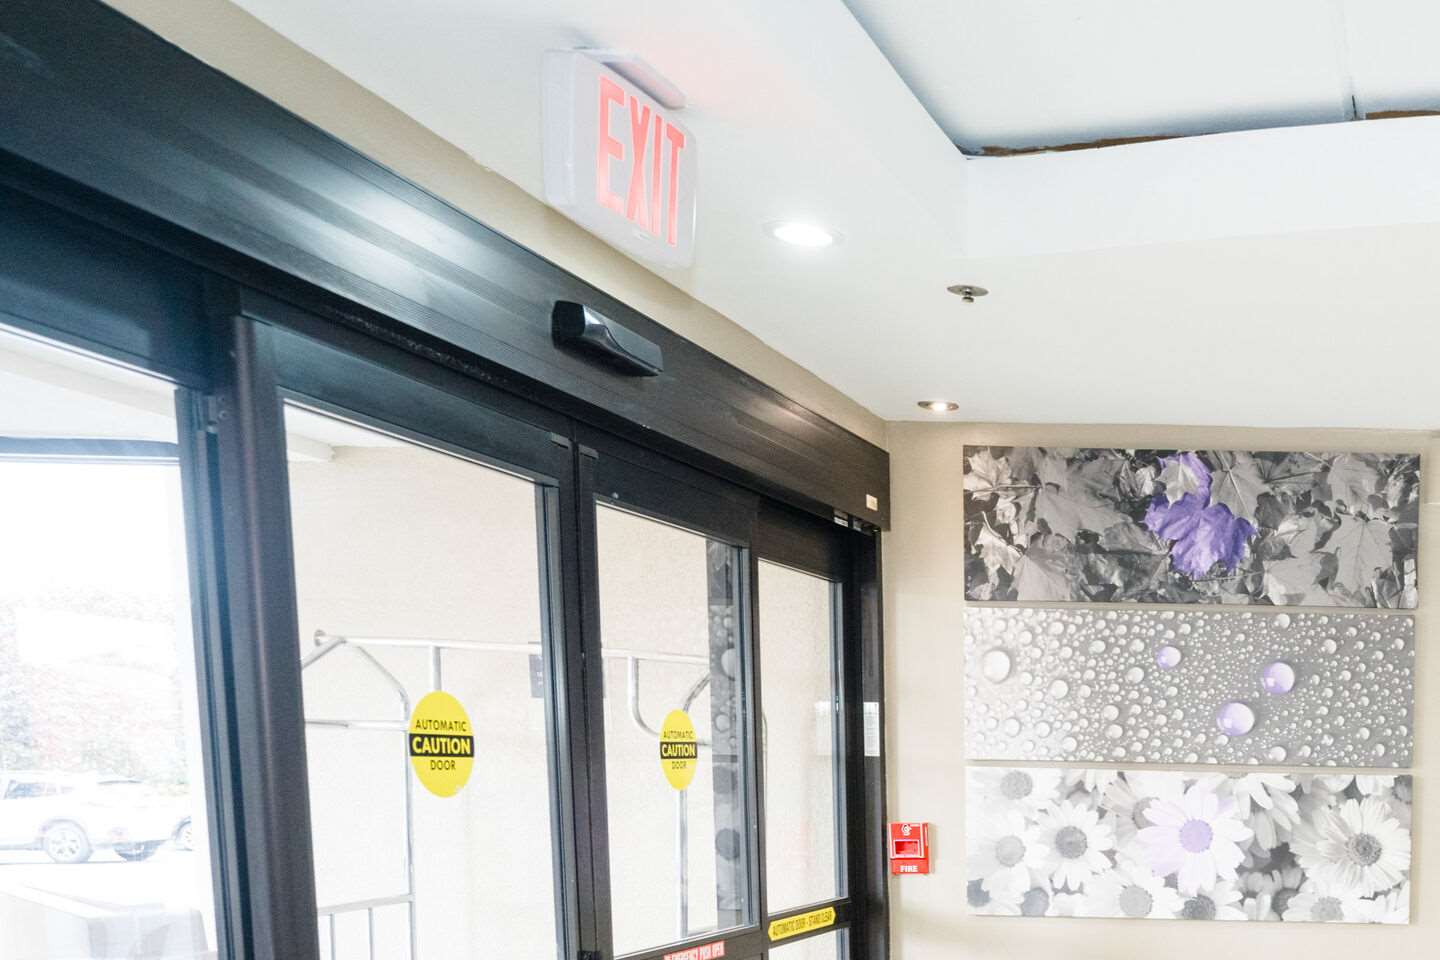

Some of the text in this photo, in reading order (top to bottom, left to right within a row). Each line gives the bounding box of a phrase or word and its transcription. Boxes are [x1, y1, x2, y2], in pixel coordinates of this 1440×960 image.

[597, 74, 685, 246] EXIT
[415, 719, 467, 732] AUTOMATIC
[412, 736, 471, 755] CAUTION
[661, 744, 696, 757] CAUTION
[430, 759, 456, 771] DOOR
[900, 865, 919, 873] FIRE
